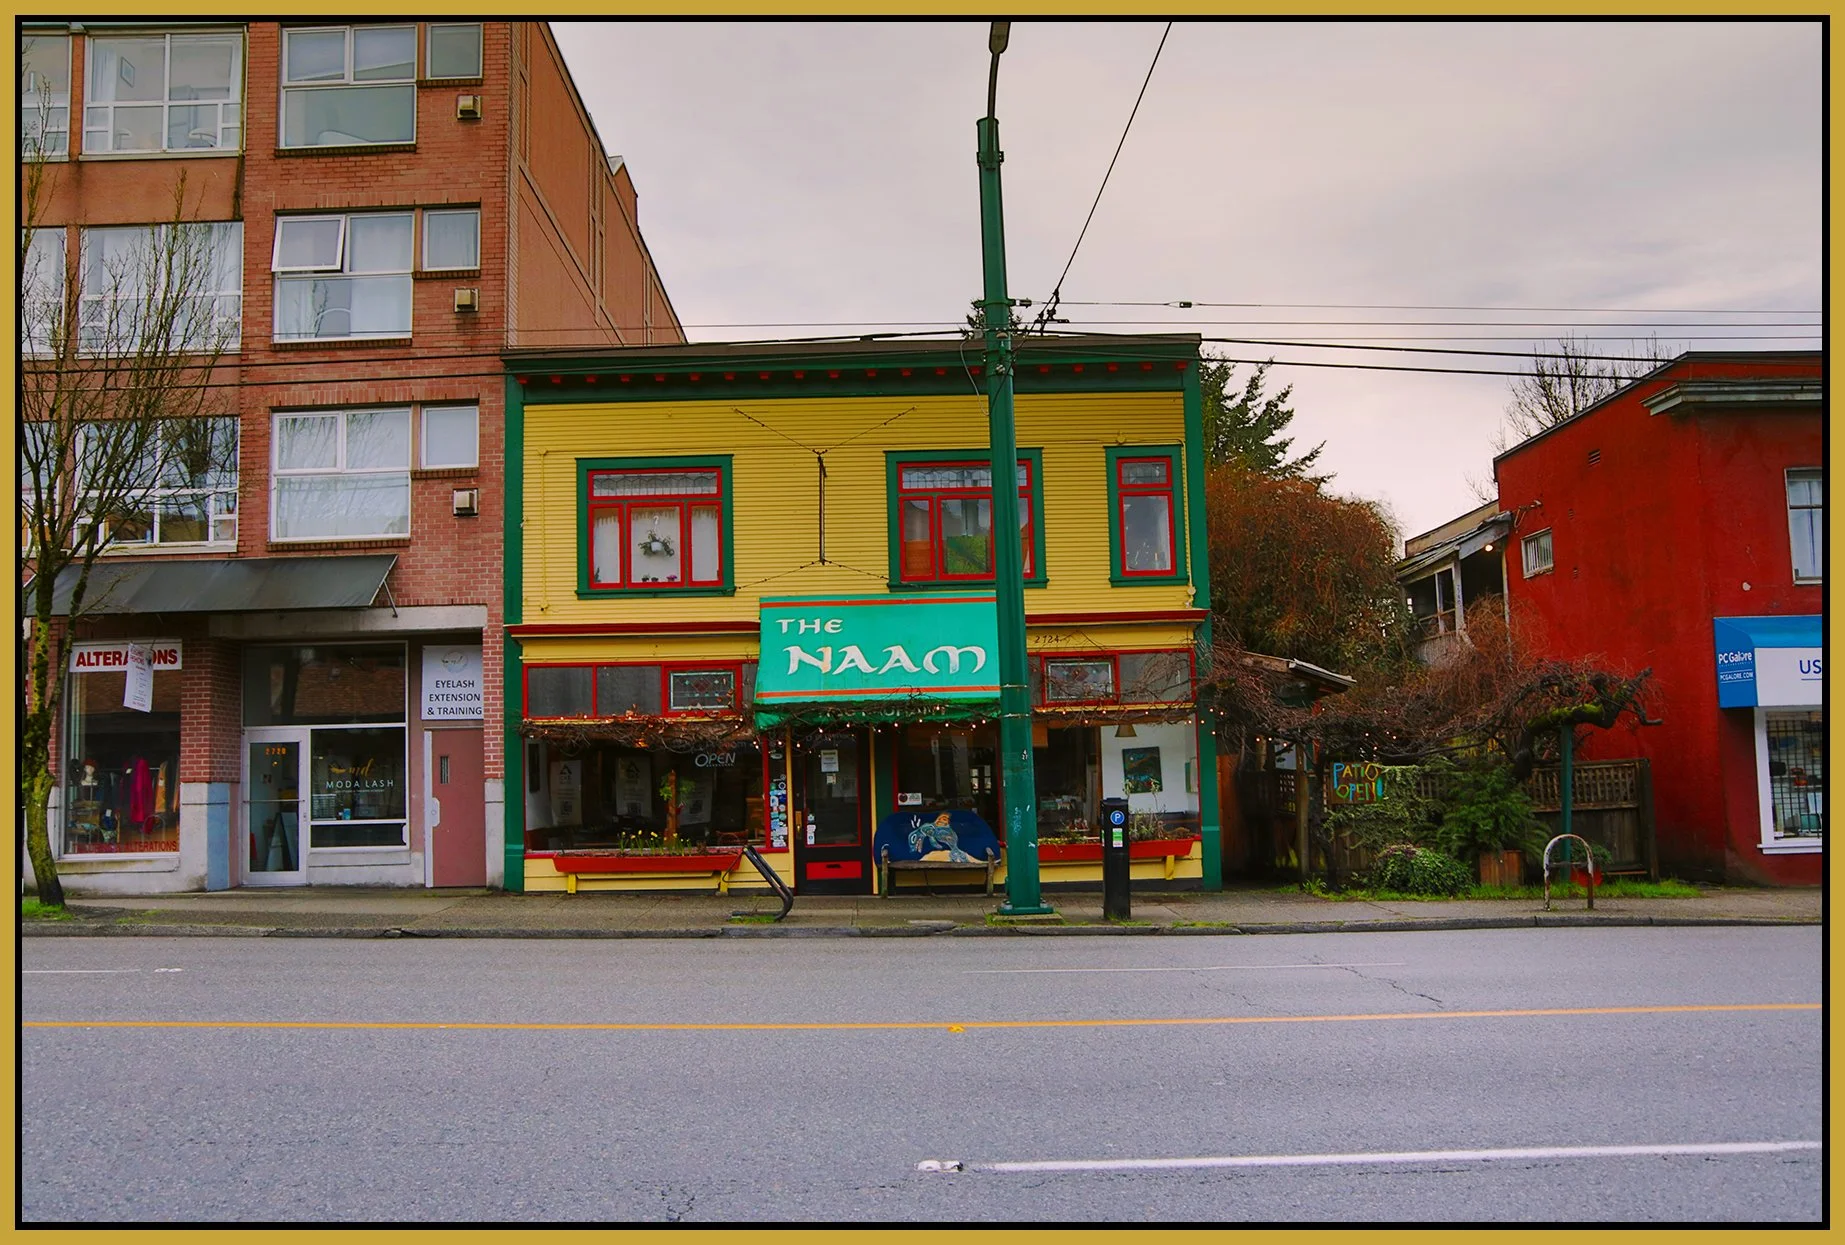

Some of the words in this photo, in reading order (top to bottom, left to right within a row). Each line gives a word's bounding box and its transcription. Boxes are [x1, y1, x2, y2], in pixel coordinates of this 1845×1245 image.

[776, 618, 843, 635] THE
[76, 648, 178, 667] ALTERNS
[783, 645, 987, 675] NAAM
[1718, 653, 1729, 664] PC
[1728, 651, 1752, 663] Galore
[1800, 659, 1822, 674] US
[435, 680, 475, 688] EYELASH
[429, 693, 481, 702] EXTENSION
[427, 707, 435, 715] &
[437, 707, 482, 715] TRAINING
[694, 752, 737, 767] OPEN
[1333, 763, 1379, 789] PATIO
[325, 780, 361, 789] MODA
[365, 779, 394, 788] LASH
